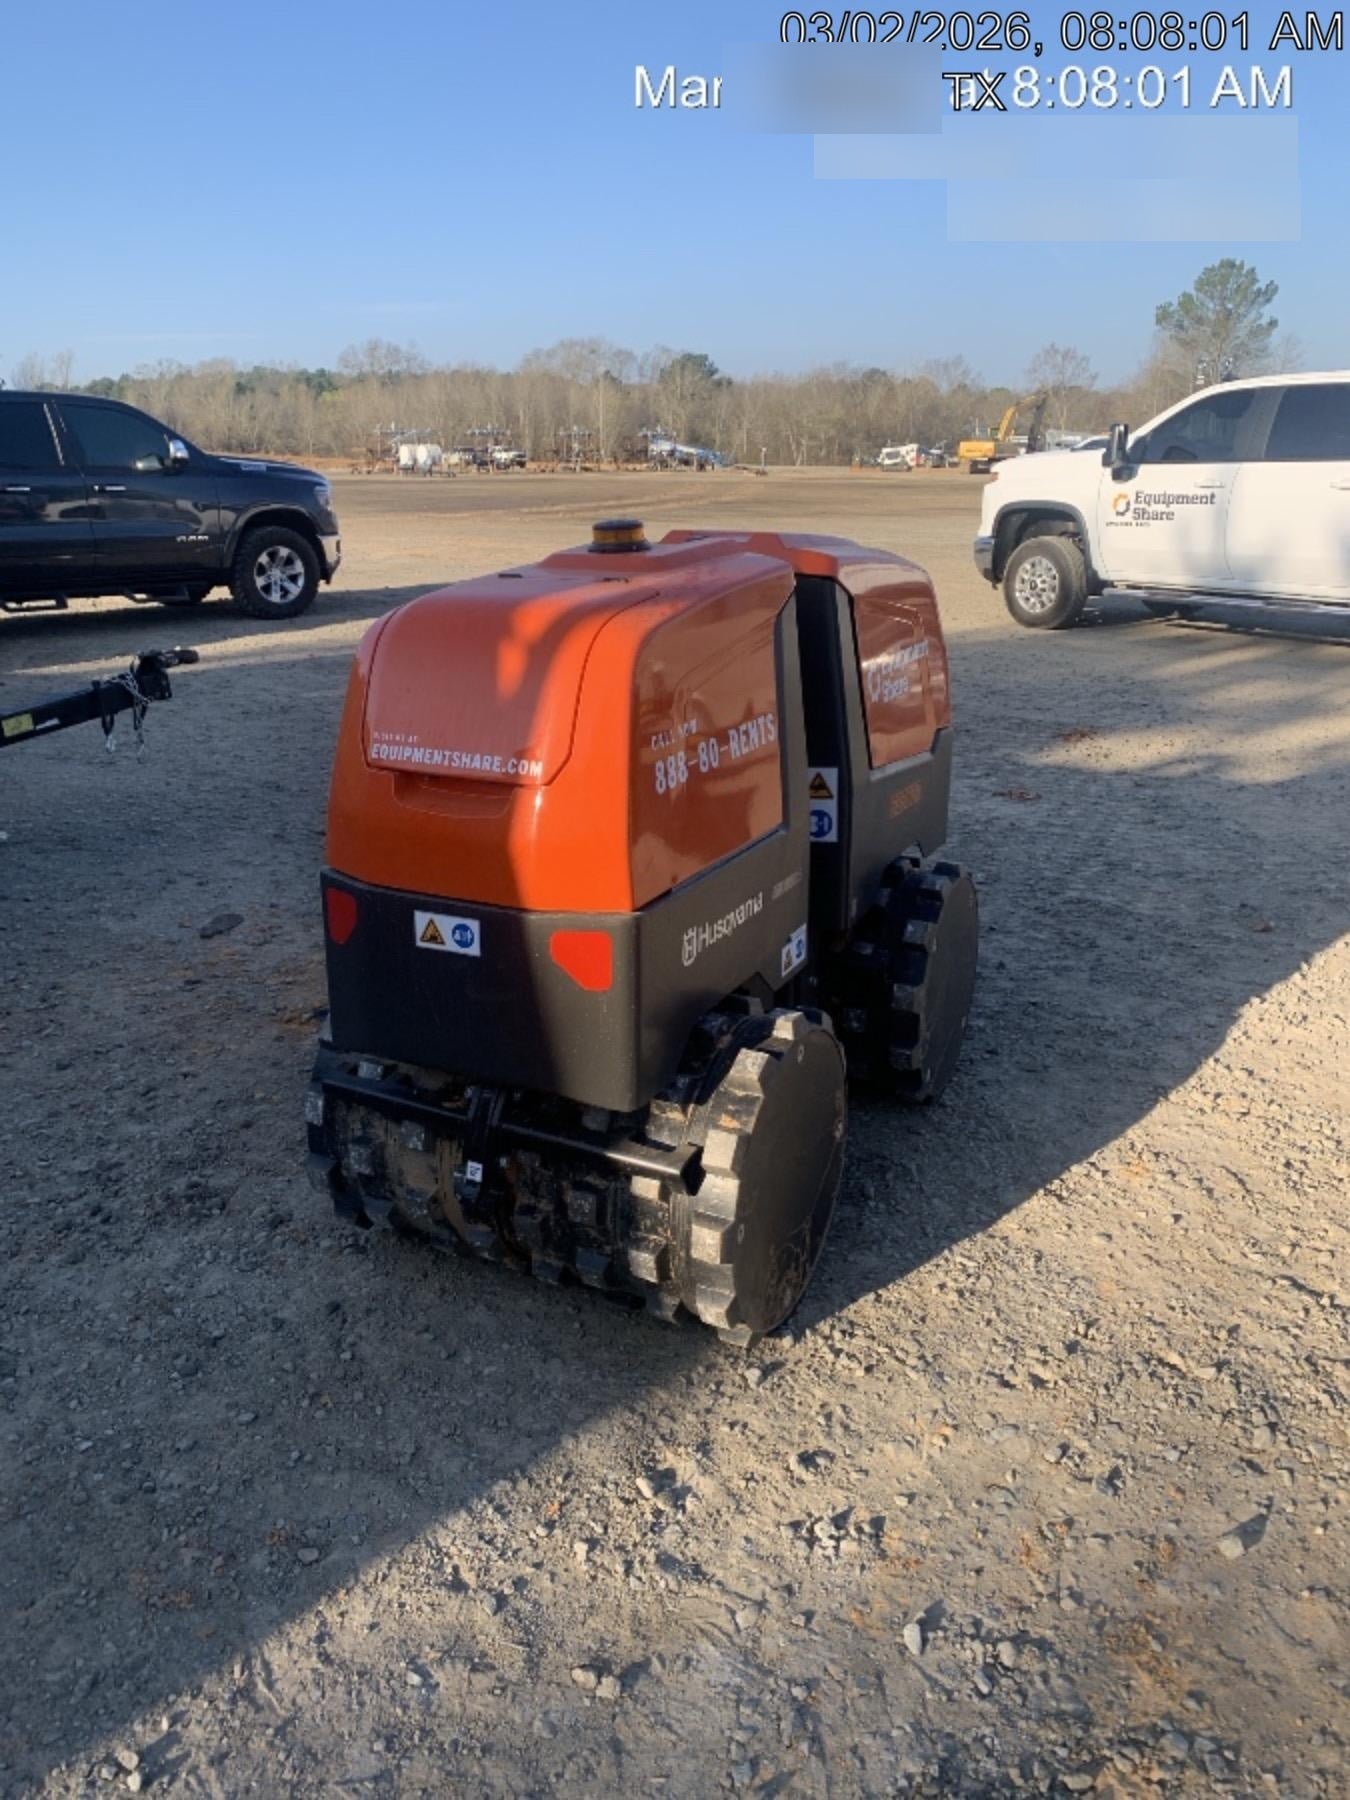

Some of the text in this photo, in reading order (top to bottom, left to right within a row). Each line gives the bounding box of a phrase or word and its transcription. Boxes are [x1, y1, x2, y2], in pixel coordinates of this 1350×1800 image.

[1134, 490, 1216, 507] Equipment
[1132, 507, 1175, 521] Share
[370, 743, 543, 777] EQUIPMENTSHARE.COM
[655, 713, 776, 795] 888-80-RENTS
